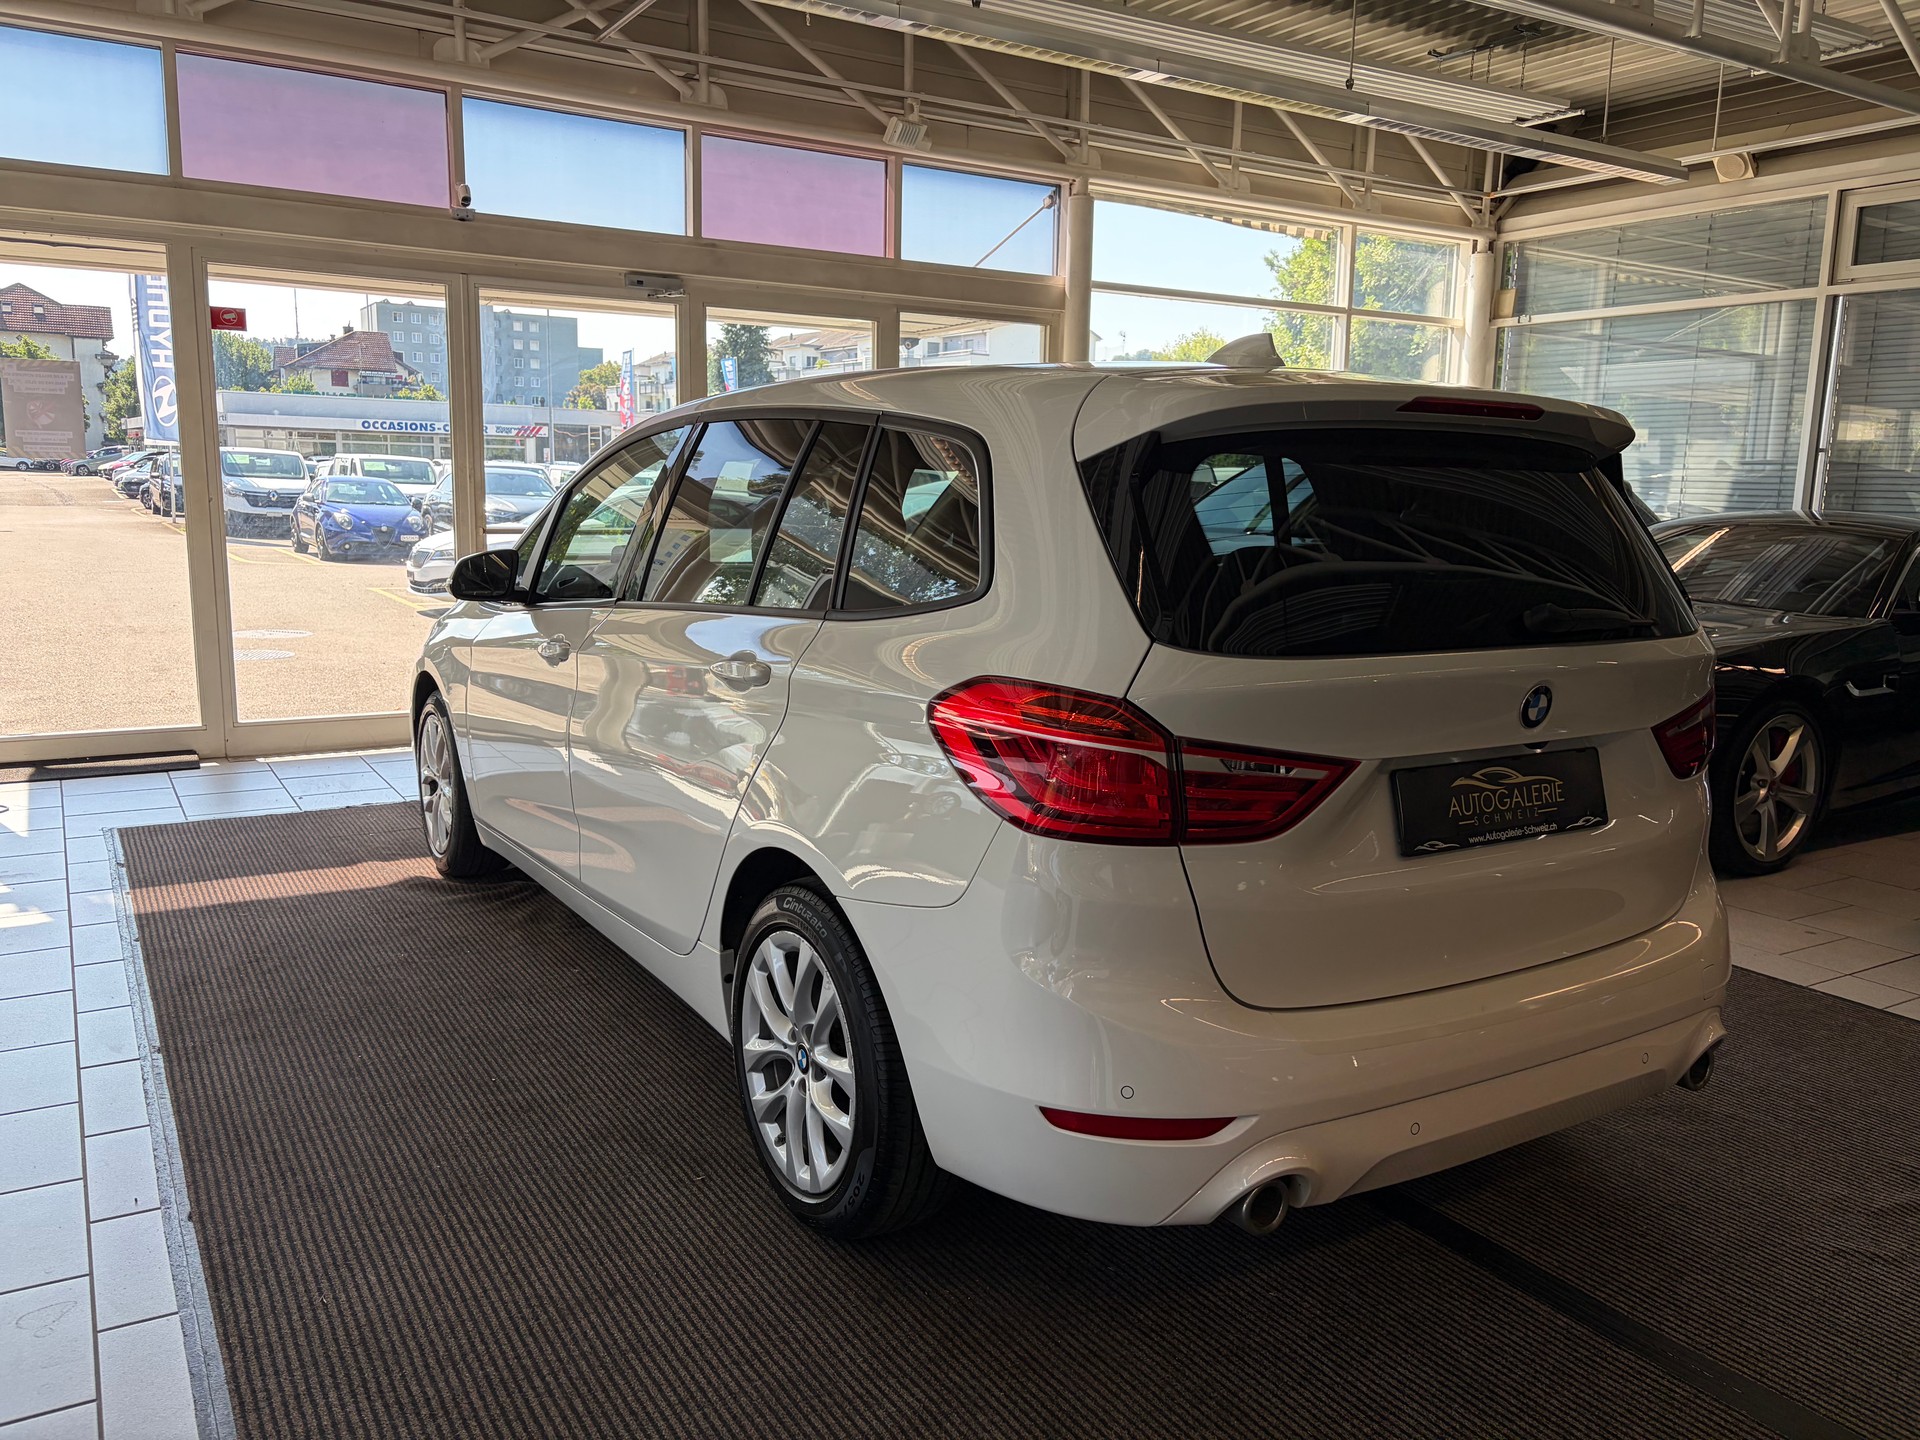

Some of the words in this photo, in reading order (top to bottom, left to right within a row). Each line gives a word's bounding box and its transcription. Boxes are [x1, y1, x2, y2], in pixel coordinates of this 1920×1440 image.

[1449, 782, 1565, 817] AUTOGALERIE
[1474, 807, 1539, 826] SCHWEIZ
[1468, 822, 1558, 844] www.Autogalerie-Schweiz.ch
